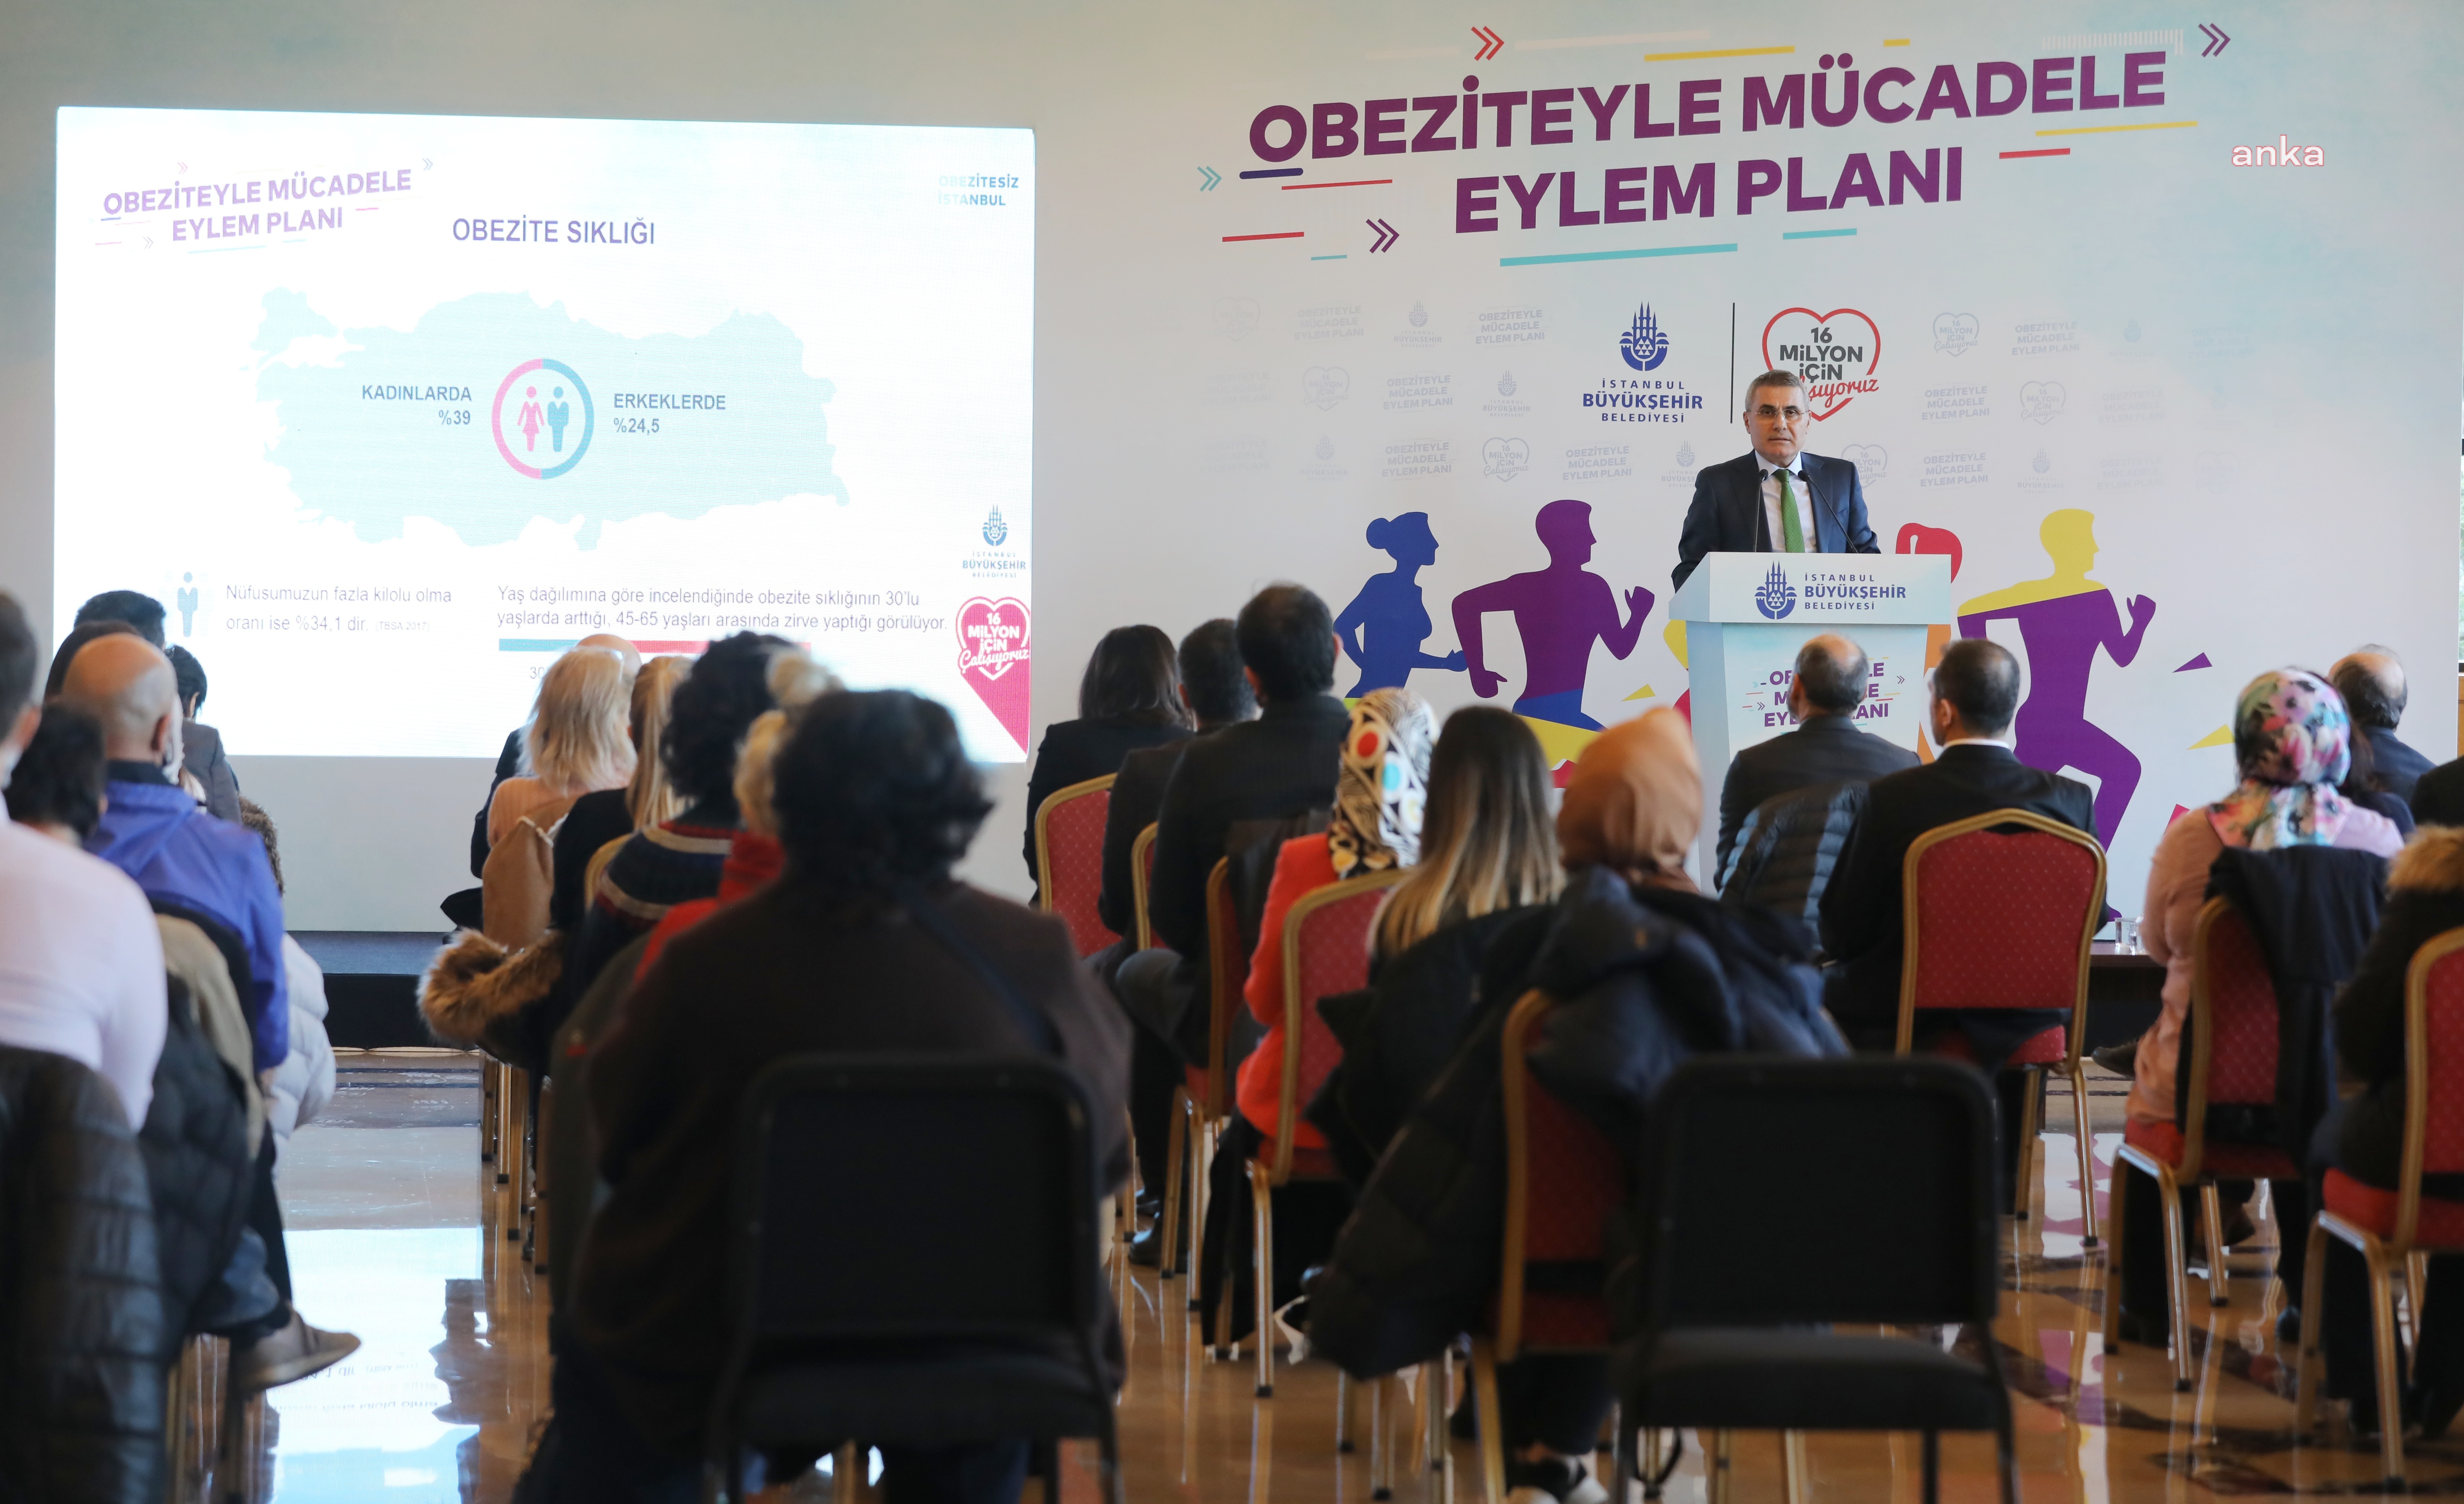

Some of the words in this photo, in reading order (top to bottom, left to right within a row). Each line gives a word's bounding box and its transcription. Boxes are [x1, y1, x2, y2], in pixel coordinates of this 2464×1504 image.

[1249, 75, 1721, 162] OBEZİTEYLE
[1742, 53, 2166, 133] MÜCADELE
[940, 173, 1018, 188] OBEZİTESİZ
[103, 181, 261, 217] OBEZİTEYLE
[268, 169, 411, 201] MÜCADELE
[1456, 162, 1715, 233] EYLEM
[1737, 147, 1962, 215] PLANI
[938, 190, 1006, 206] İSTANBUL
[173, 214, 259, 241] EYLEM
[267, 207, 342, 233] PLANI
[453, 215, 558, 242] OBEZİTE
[567, 217, 655, 244] SIKLIĞI
[1297, 306, 1361, 317] OBEZİTEYLE
[1479, 310, 1543, 321] OBEZİTEYLE
[1300, 317, 1359, 329] MÜCADELE
[1481, 321, 1539, 332] MÜCADELE
[2015, 321, 2077, 333] OBEZİTEYLE
[1294, 330, 1330, 340] EYLEM
[1333, 328, 1364, 338] PLANI
[1476, 334, 1512, 344] EYLEM
[1513, 332, 1545, 341] PLANI
[1811, 328, 1832, 343] 16
[2017, 332, 2074, 343] MÜCADELE
[2012, 346, 2046, 355] EYLEM
[2049, 343, 2080, 353] PLANI
[1387, 375, 1450, 387] OBEZİTEYLE
[1602, 379, 1684, 390] İSTANBUL
[362, 385, 472, 401] KADINLARDA
[1389, 386, 1447, 398] MÜCADELE
[1800, 375, 1879, 408] şıyoruz
[1925, 386, 1987, 398] OBEZİTEYLE
[613, 393, 726, 410] ERKEKLERDE
[1384, 400, 1419, 410] EYLEM
[1422, 397, 1453, 407] PLANI
[1583, 391, 1702, 410] BÜYÜKŞEHİR
[1927, 397, 1984, 408] MÜCADELE
[438, 410, 471, 425] %39
[1601, 412, 1684, 423] BELEDİYESİ
[1922, 410, 1956, 420] EYLEM
[1959, 408, 1989, 418] PLANI
[613, 417, 660, 435] %24,5
[1385, 442, 1449, 454] OBEZİTEYLE
[1566, 446, 1629, 457] OBEZİTEYLE
[1388, 454, 1446, 465] MÜCADELE
[1568, 457, 1626, 468] MÜCADELE
[1923, 453, 1986, 464] OBEZİTEYLE
[1382, 467, 1417, 477] EYLEM
[1420, 464, 1451, 474] PLANI
[1563, 470, 1598, 481] EYLEM
[1601, 468, 1631, 478] PLANI
[1926, 464, 1983, 475] MÜCADELE
[1921, 477, 1955, 487] EYLEM
[1958, 475, 1988, 484] PLANI
[1805, 573, 1874, 582] İSTANBUL
[226, 585, 328, 600] Nüfusumuzun
[334, 586, 368, 601] fazla
[374, 587, 410, 602] kilolu
[416, 587, 451, 602] olma
[498, 586, 524, 604] Yaş
[530, 587, 606, 604] dağılımına
[612, 589, 643, 605] göre
[650, 588, 753, 607] incelendiğinde
[758, 589, 810, 605] obezite
[816, 590, 880, 608] sıklığının
[886, 590, 919, 606] 30'lu
[1805, 584, 1906, 599] BÜYÜKŞEHİR
[1805, 601, 1874, 610] BELEDİYESİ
[226, 617, 263, 630] oranı
[270, 616, 290, 630] ise
[296, 616, 340, 632] %34,1
[348, 616, 368, 631] dir.
[498, 611, 559, 628] yaşlarda
[565, 611, 610, 628] arttığı,
[617, 611, 658, 626] 45-65
[663, 612, 710, 631] yaşları
[716, 614, 778, 627] arasında
[785, 614, 818, 627] zirve
[824, 614, 871, 631] yaptığı
[877, 615, 947, 632] görülüyor.
[987, 613, 1000, 625] 16
